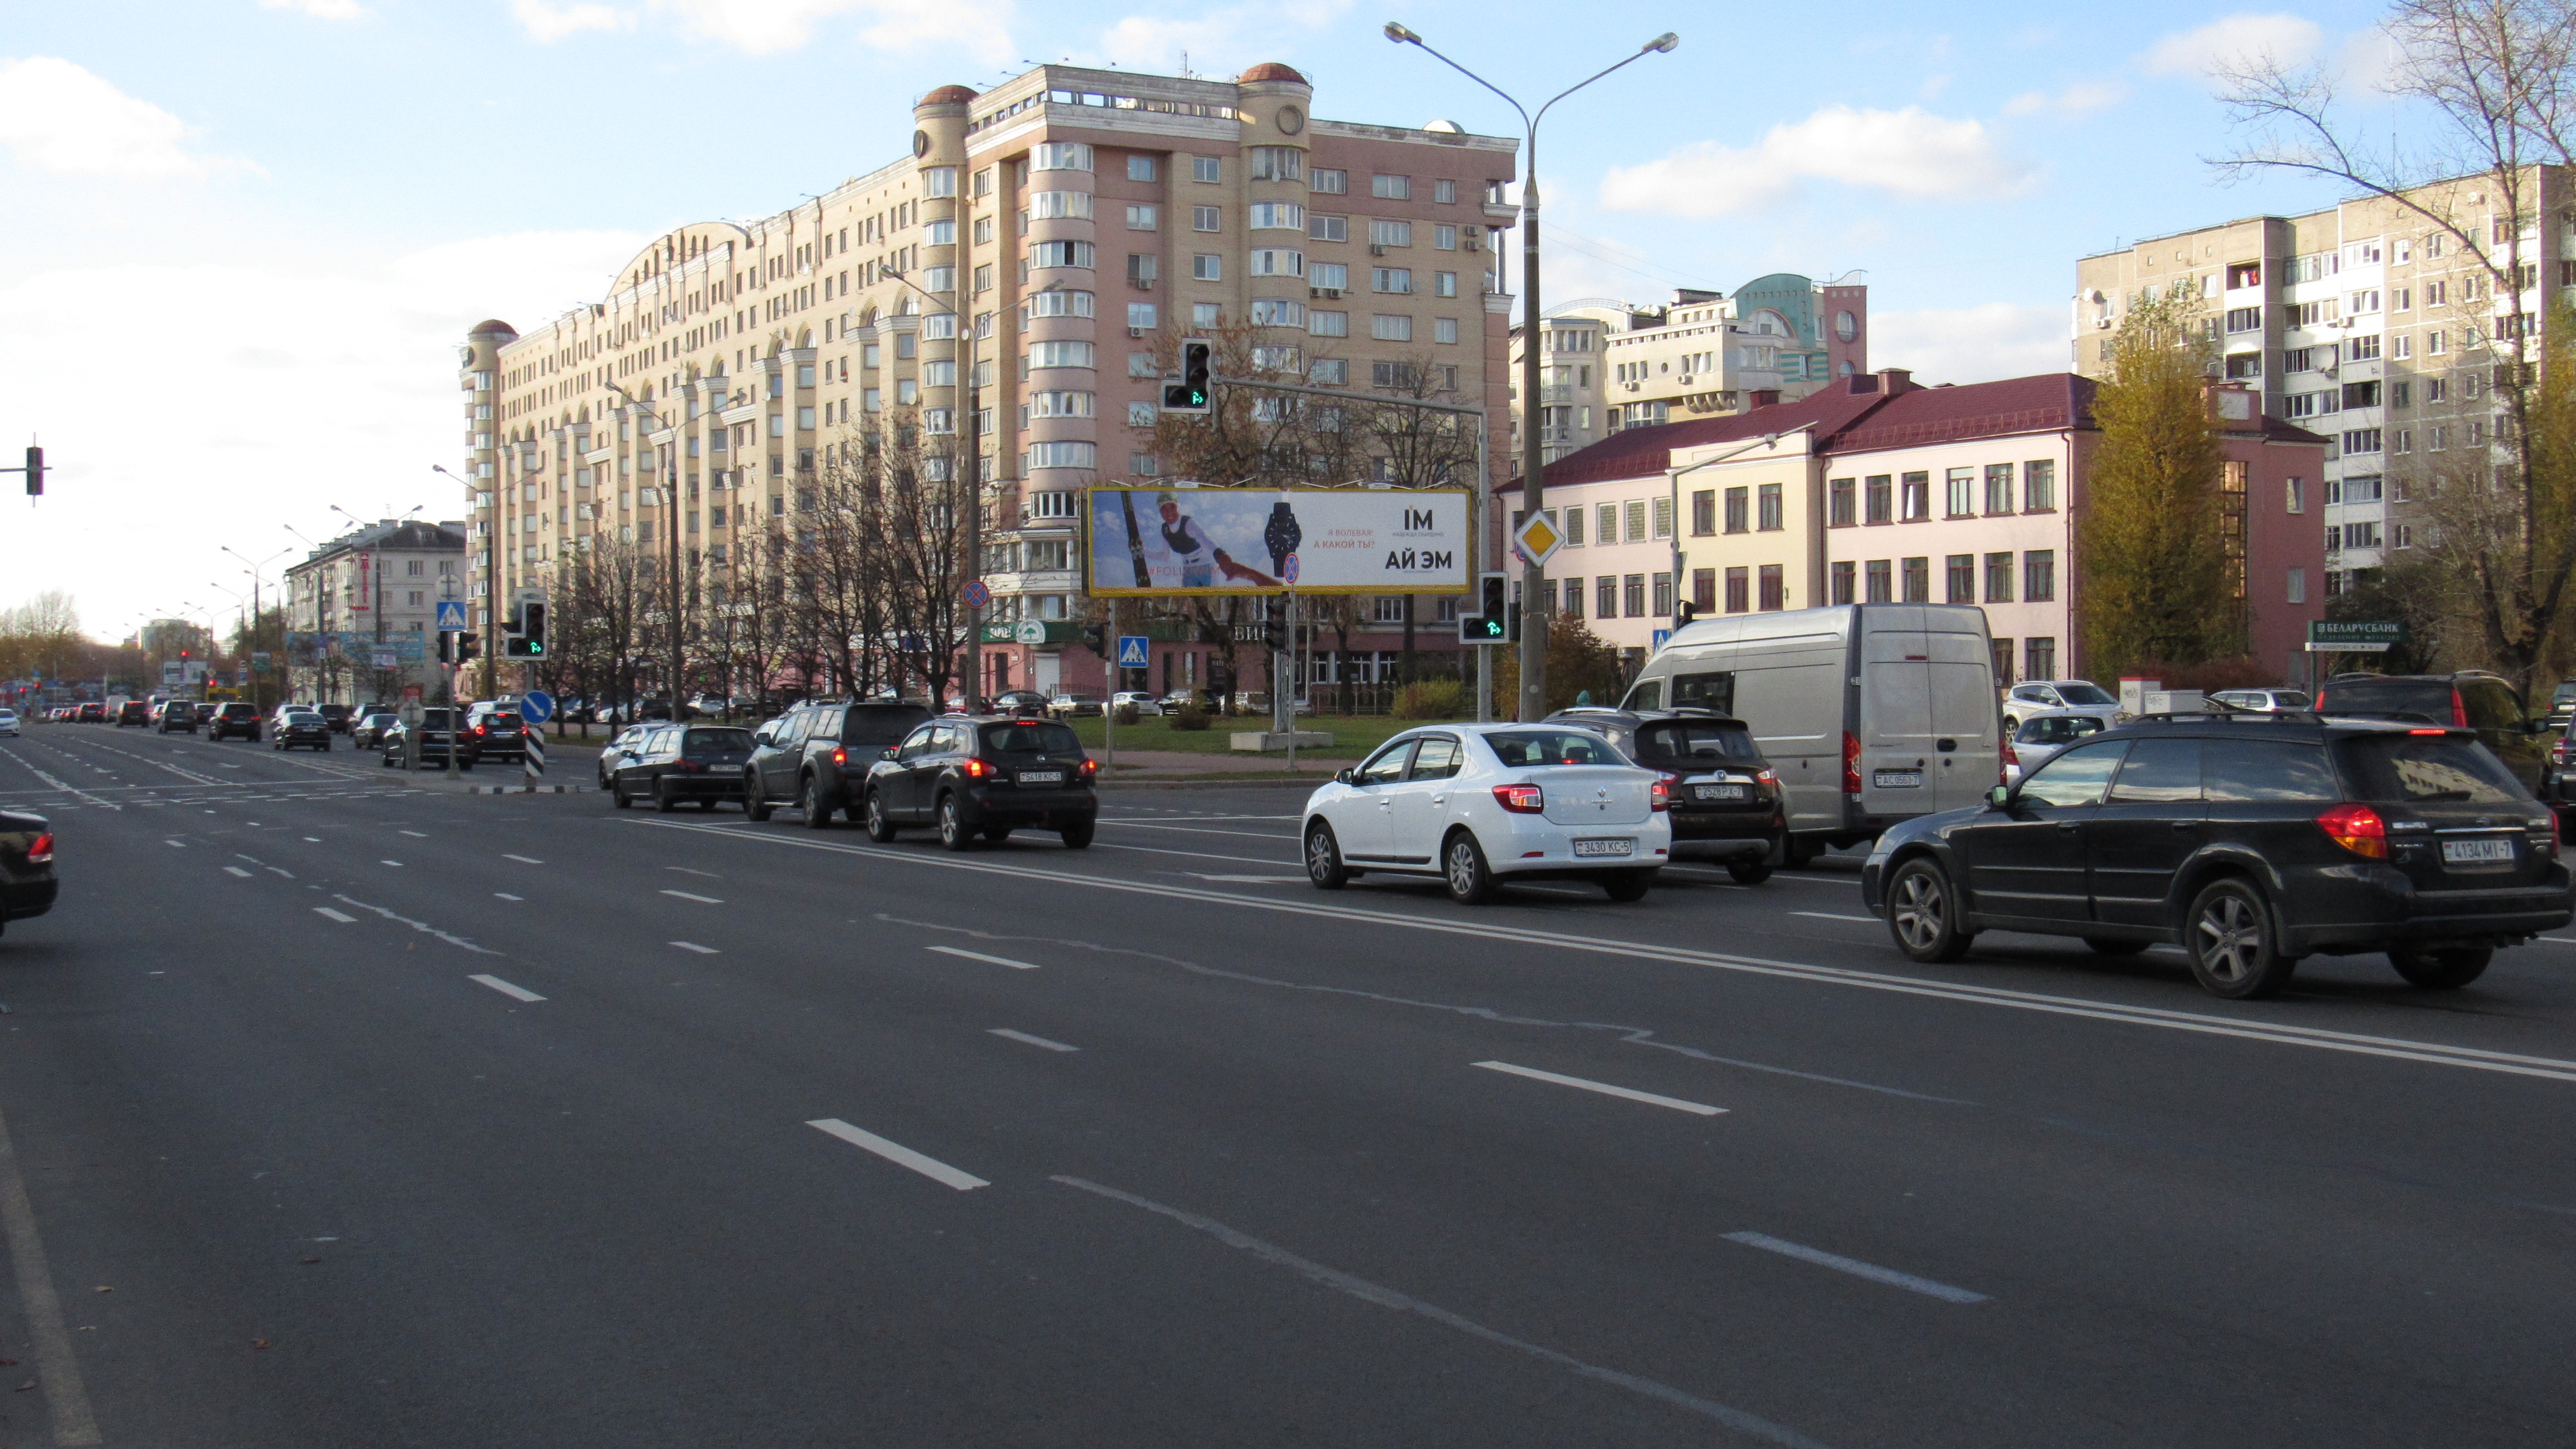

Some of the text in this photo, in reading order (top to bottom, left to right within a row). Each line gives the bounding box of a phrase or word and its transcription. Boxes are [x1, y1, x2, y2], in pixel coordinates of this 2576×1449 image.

[1323, 538, 1355, 548] КАКОЙ
[1357, 540, 1375, 548] ТЫ?
[1385, 547, 1452, 569] АЙ ЭМ
[2327, 622, 2399, 633] БЕЛАРУСБАНК
[1026, 773, 1043, 781] 5418
[1703, 786, 1721, 796] 2528
[1584, 841, 1630, 853] 3430 KC-5
[2455, 842, 2481, 858] 4134
